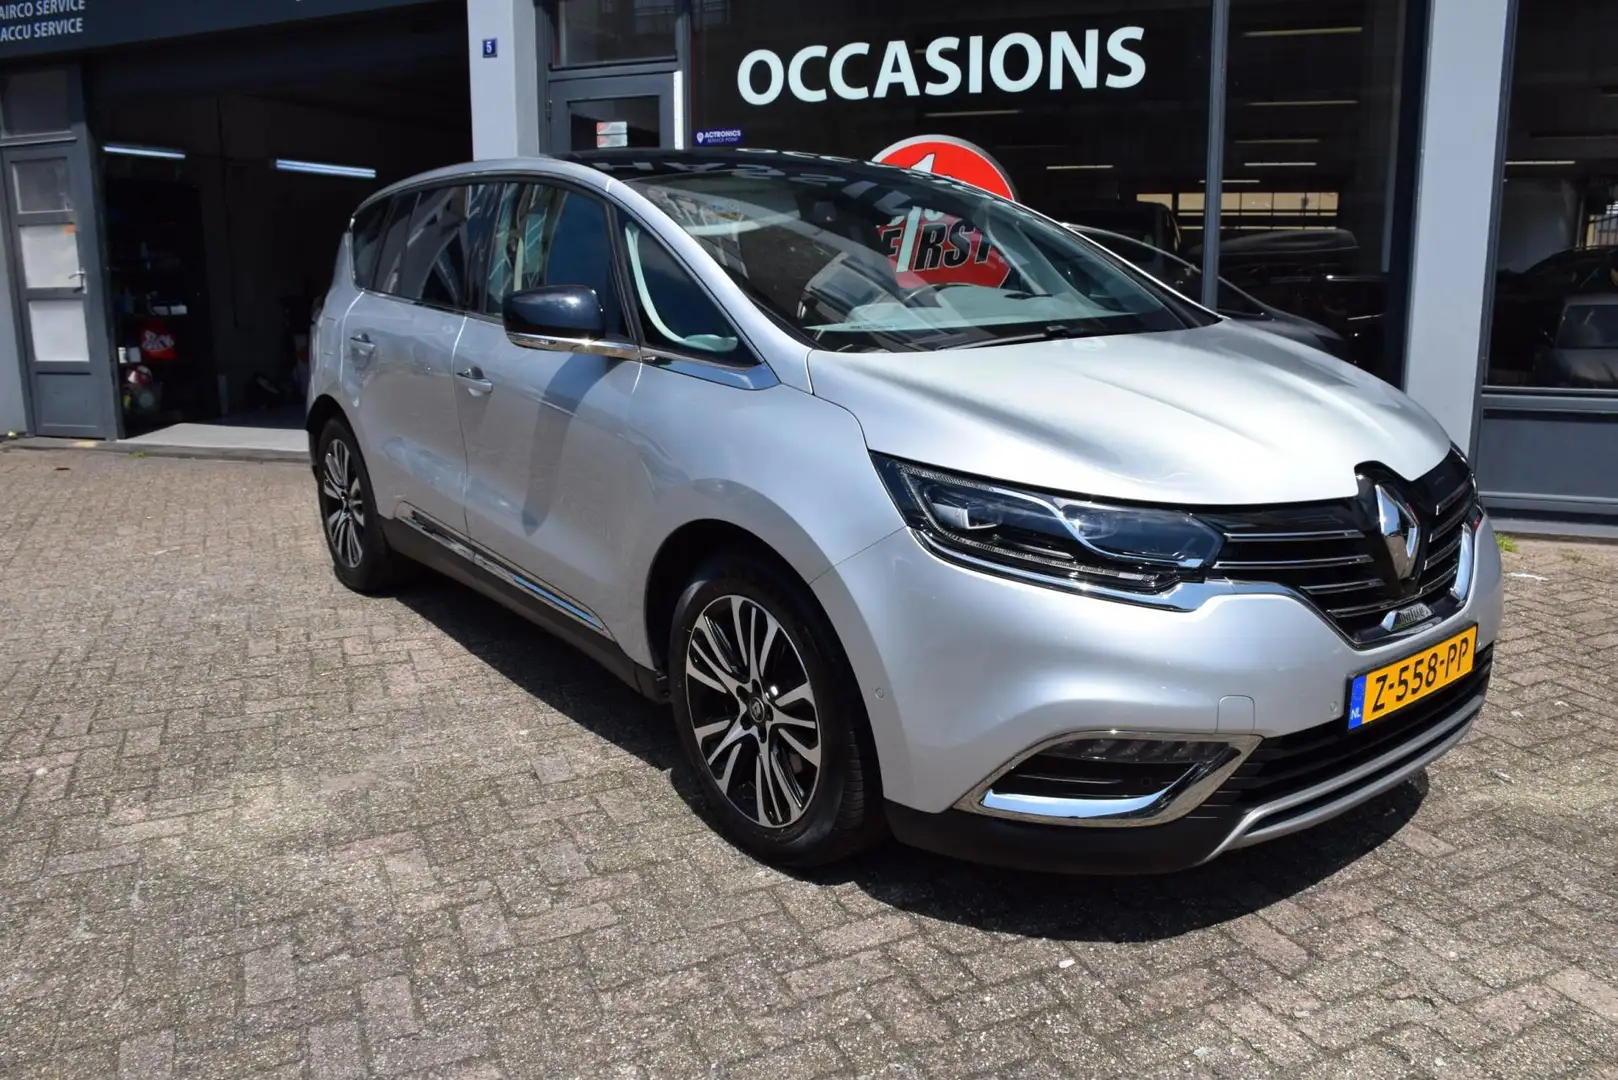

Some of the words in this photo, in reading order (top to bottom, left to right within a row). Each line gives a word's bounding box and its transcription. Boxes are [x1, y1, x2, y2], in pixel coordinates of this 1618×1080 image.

[0, 2, 33, 19] AIRCO
[36, 0, 85, 15] SERVICE
[0, 24, 31, 42] ACCU
[34, 17, 83, 37] SERVICE
[737, 26, 1146, 105] OCCASIONS
[705, 130, 741, 138] ACTRONICS
[1371, 637, 1469, 714] Z-558-PP
[1350, 707, 1361, 720] NL
